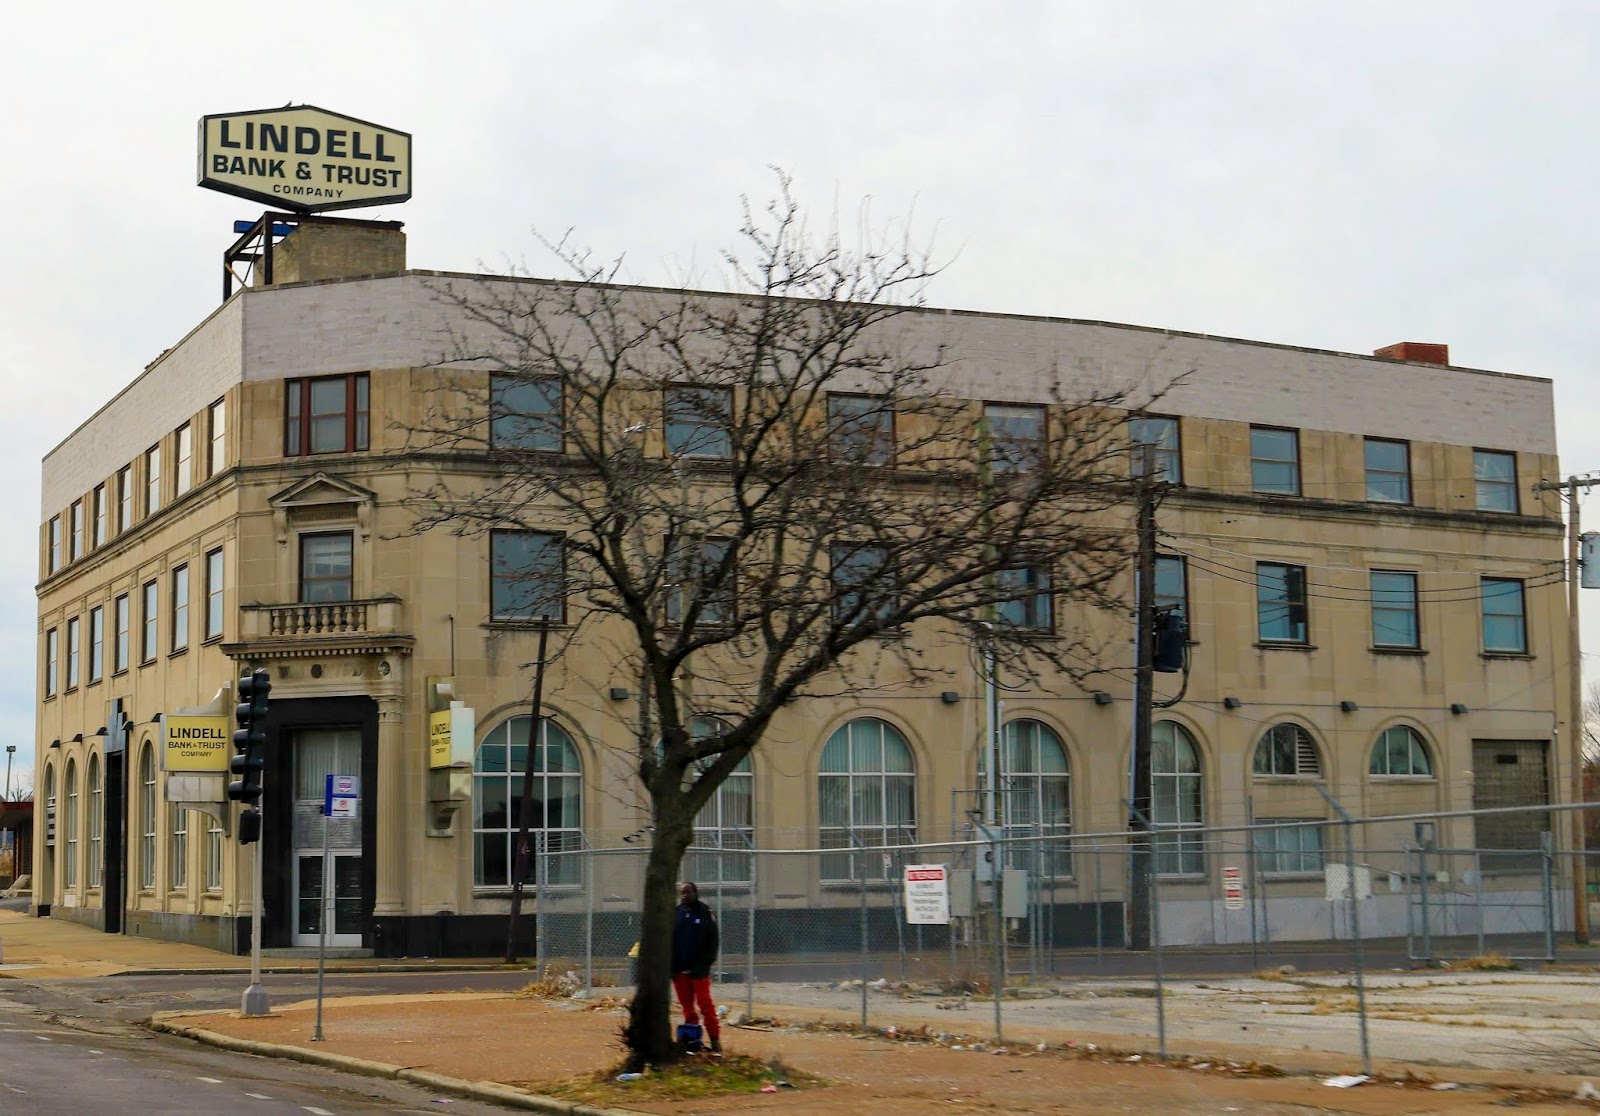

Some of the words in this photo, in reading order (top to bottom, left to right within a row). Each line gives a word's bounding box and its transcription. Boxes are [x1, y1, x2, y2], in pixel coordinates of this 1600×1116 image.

[220, 119, 396, 163] LINDELL
[213, 154, 286, 178] BANK
[295, 161, 312, 180] &
[322, 164, 402, 188] TRUST
[273, 184, 344, 199] COMPANY
[170, 727, 226, 739] LINDELL
[168, 741, 192, 749] BANK
[197, 741, 226, 749] TRUST
